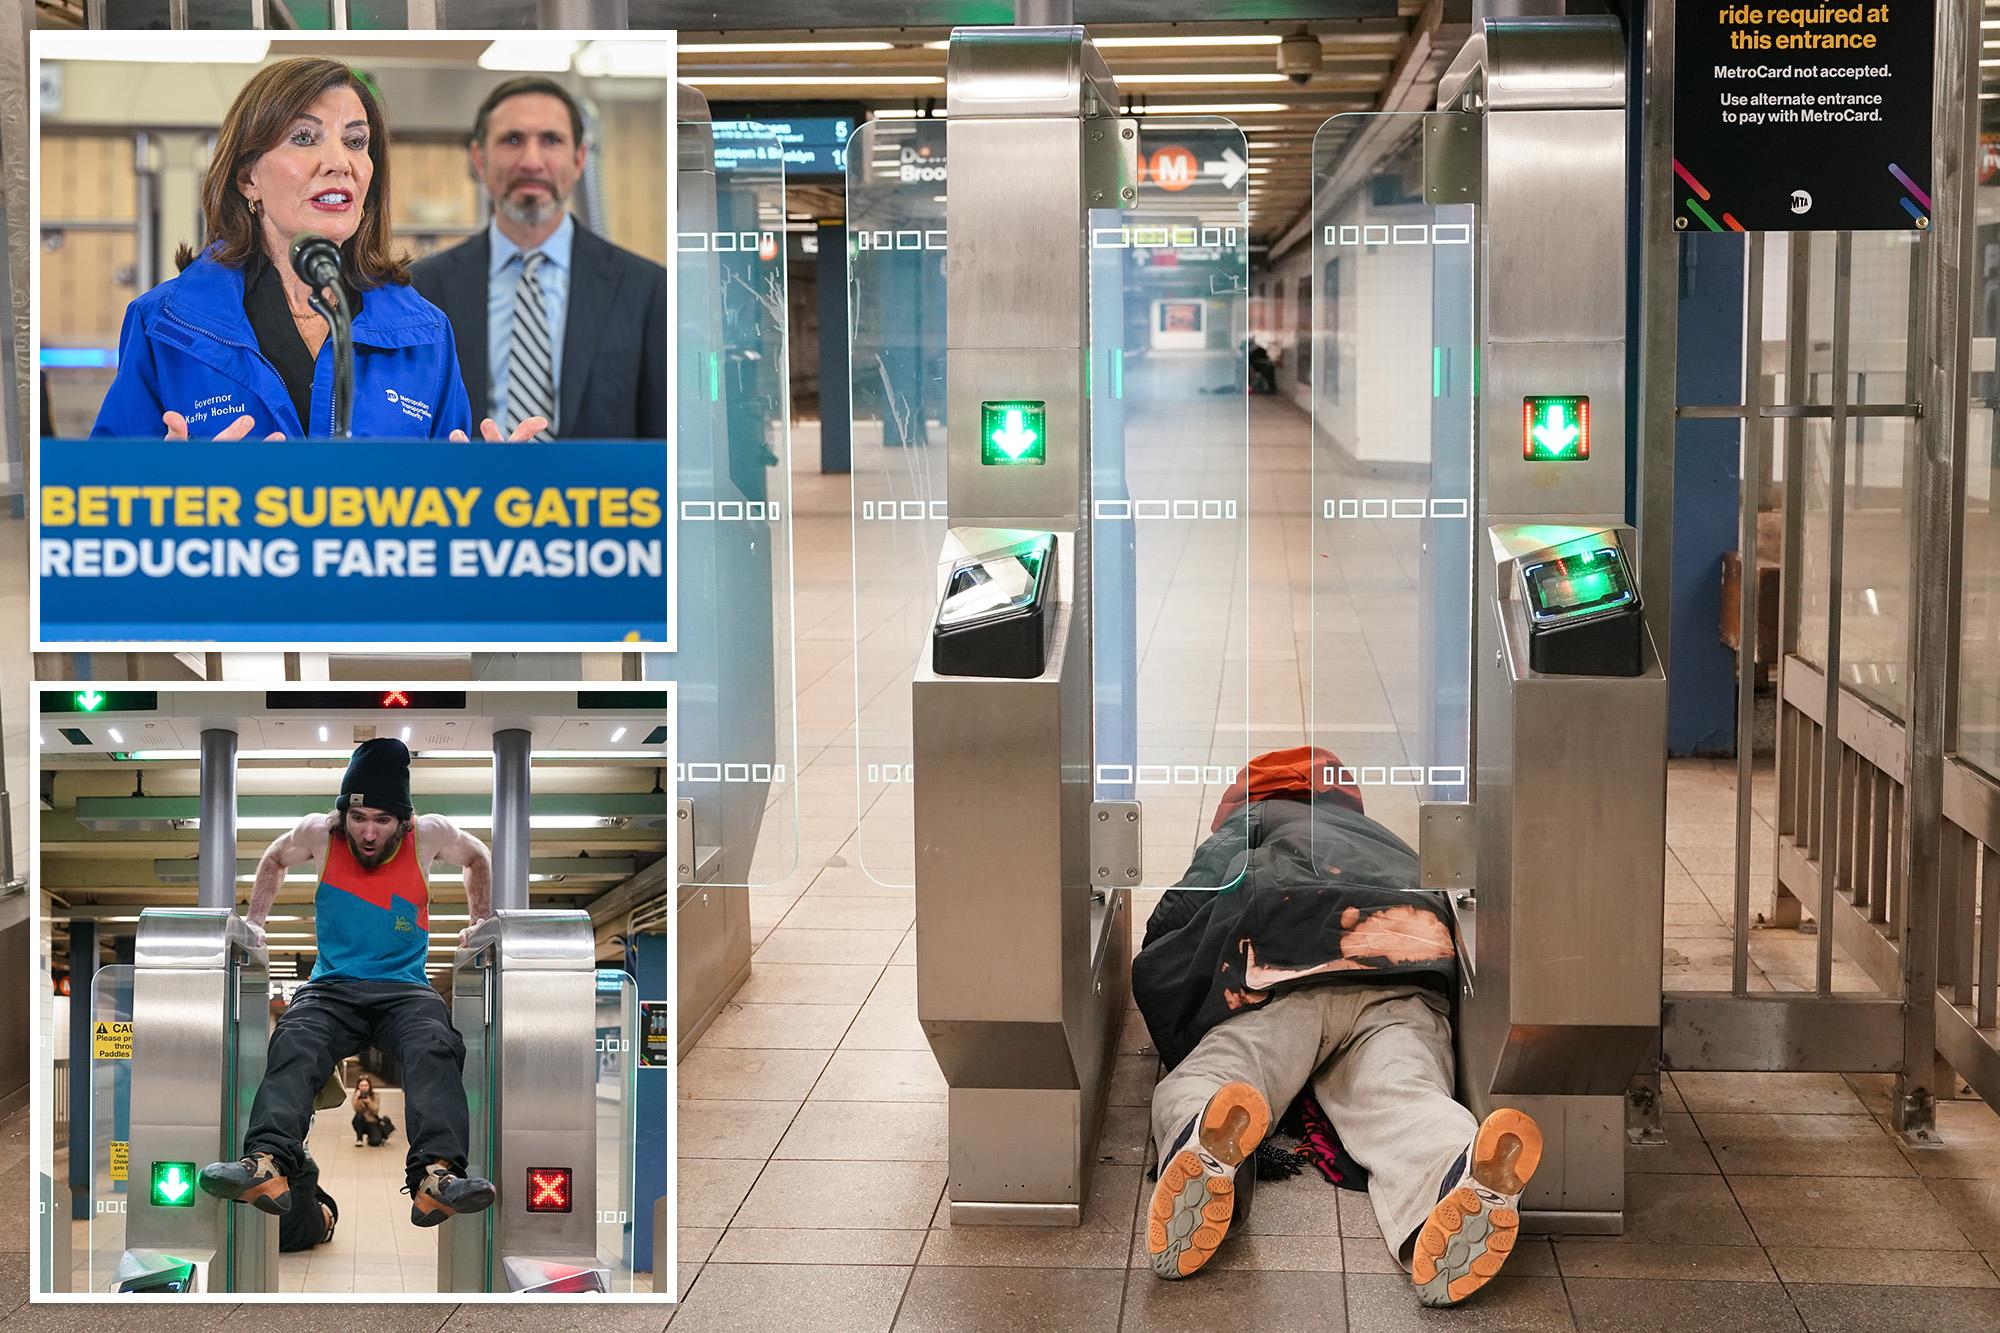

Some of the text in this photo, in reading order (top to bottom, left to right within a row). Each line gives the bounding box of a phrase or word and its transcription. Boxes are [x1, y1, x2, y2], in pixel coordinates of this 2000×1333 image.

[1719, 4, 1889, 27] ride required at
[1730, 30, 1877, 50] this entrance
[1714, 64, 1892, 80] MetroCard not accepted.
[1720, 92, 1883, 106] Use alternate entrance
[1722, 109, 1883, 126] to pay with MetroCard.
[835, 120, 848, 138] 5
[1157, 155, 1189, 182] M
[1790, 192, 1811, 211] MTA
[194, 394, 232, 410] Governor
[184, 403, 245, 424] Kathy Hochul
[41, 486, 661, 527] BETTER SUBWAY GATES
[40, 538, 662, 577] REDUCING FARE EVASION
[96, 1034, 122, 1042] Please
[99, 1050, 131, 1058] Paddles
